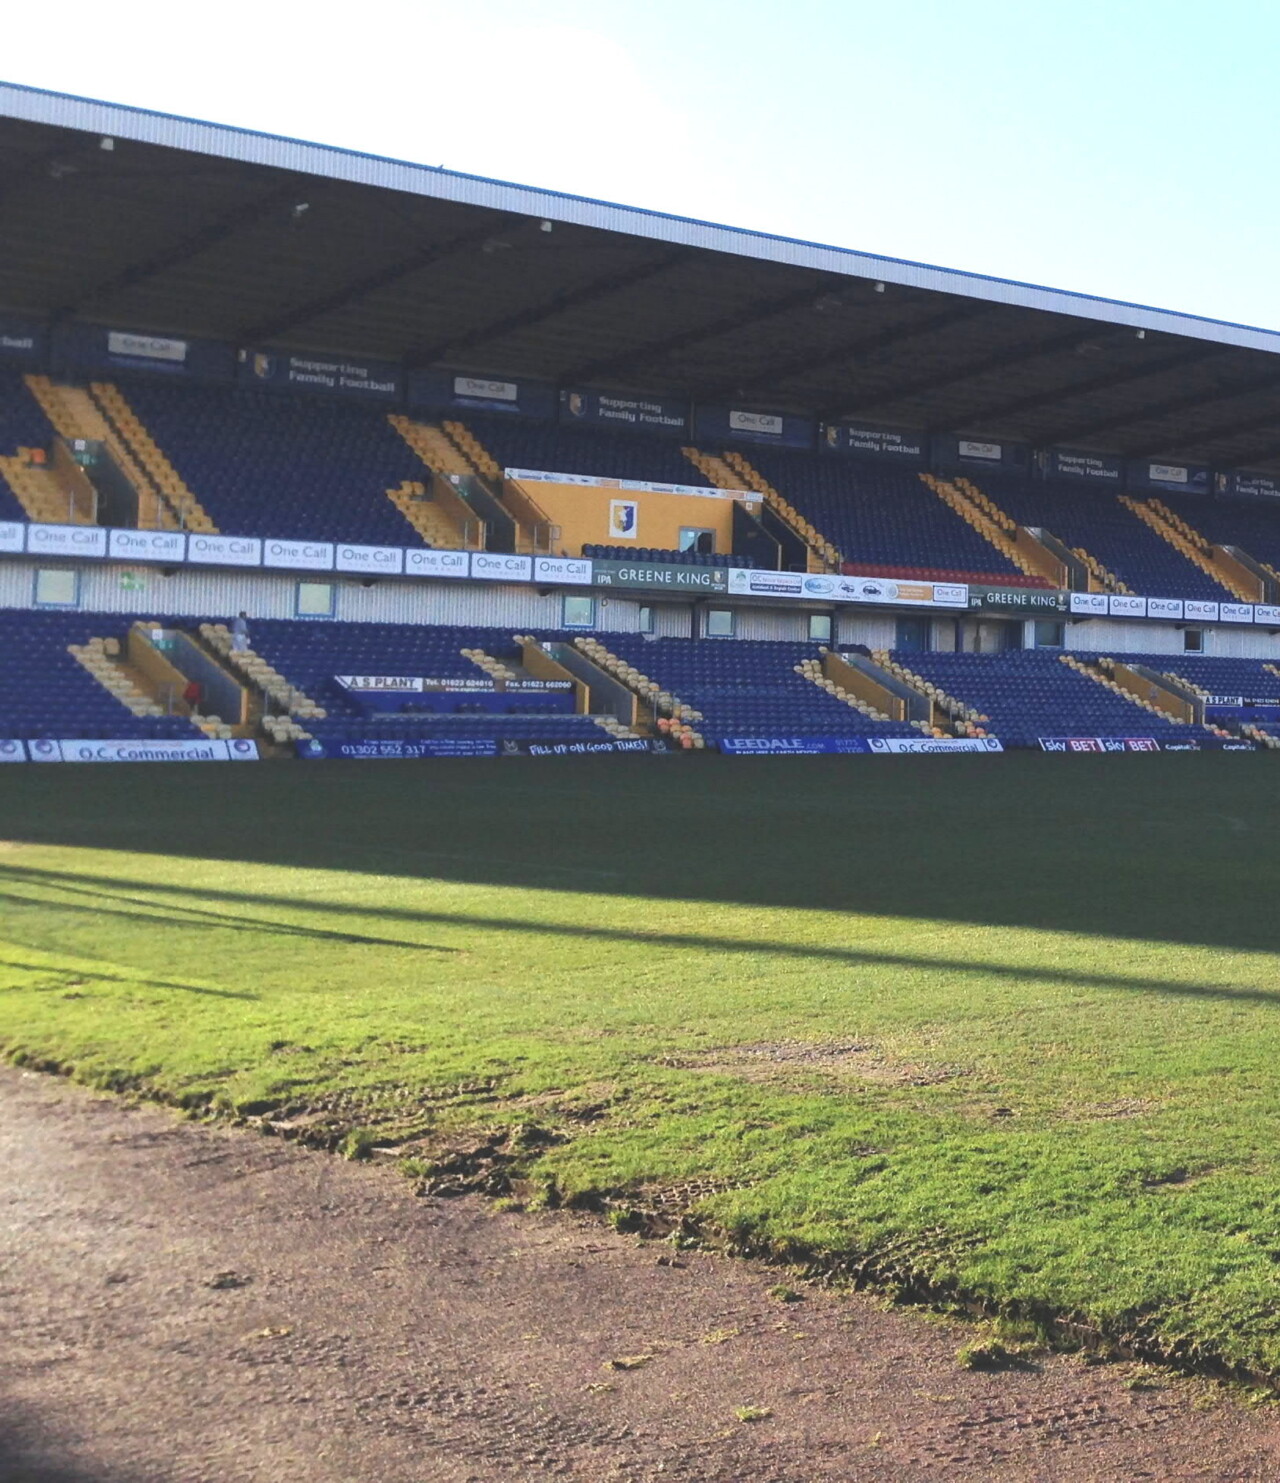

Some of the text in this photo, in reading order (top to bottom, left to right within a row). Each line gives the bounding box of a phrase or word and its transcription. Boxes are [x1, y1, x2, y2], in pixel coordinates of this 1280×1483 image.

[290, 357, 368, 378] Supporting
[290, 370, 395, 392] Family Football
[599, 396, 662, 414] Supporting
[599, 408, 685, 427] Family Football
[849, 428, 902, 443] Supporting
[849, 438, 921, 455] Family Football
[1058, 454, 1103, 467] Supporting
[1086, 467, 1119, 478] Football
[35, 527, 99, 544] One Call
[116, 533, 178, 550] One Call
[194, 540, 254, 555] One Call
[270, 544, 327, 559] One Call
[342, 549, 396, 563] One Call
[411, 553, 463, 567] One Call
[476, 557, 526, 570] One Call
[539, 562, 563, 573] One
[566, 563, 587, 575] Call
[597, 575, 612, 585] IPA
[618, 568, 711, 585] GREENE KING
[986, 592, 1056, 607] GREENE KING
[1073, 596, 1105, 607] One Call
[1112, 599, 1143, 610] One Call
[1150, 601, 1180, 612] One Call
[1186, 604, 1216, 614] One Call
[1222, 606, 1251, 616] One Call
[1257, 609, 1270, 617] One
[350, 677, 416, 689] A S PLANT
[341, 745, 378, 755] 01302
[405, 745, 426, 755] 317
[529, 740, 649, 756] FILL UP ON GOOD TIMES!
[723, 739, 805, 749] LEEDALE
[920, 743, 979, 753] Commercial
[1045, 740, 1098, 751] sky BET
[1105, 740, 1154, 751] sky BET
[117, 746, 214, 760] Commercial
